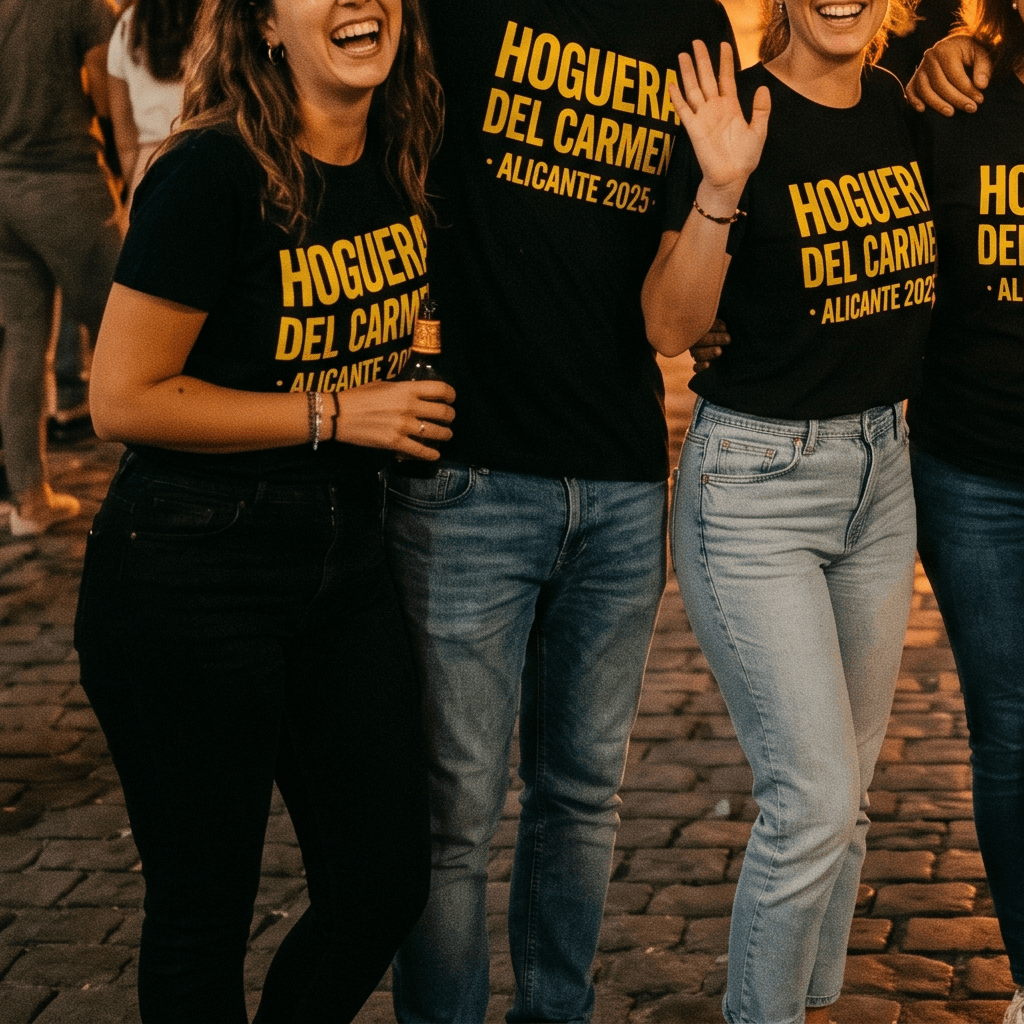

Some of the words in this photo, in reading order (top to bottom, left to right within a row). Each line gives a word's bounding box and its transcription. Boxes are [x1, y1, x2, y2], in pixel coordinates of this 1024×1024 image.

[495, 20, 680, 126] HOGUERA
[482, 88, 543, 147] DEL
[496, 152, 601, 204] ALICANTE
[603, 179, 651, 214] 2025
[801, 240, 858, 289] DEL
[863, 220, 938, 278] CARME
[275, 315, 339, 361] DEL
[348, 283, 429, 353] CARM
[821, 283, 901, 324] ALICANTE
